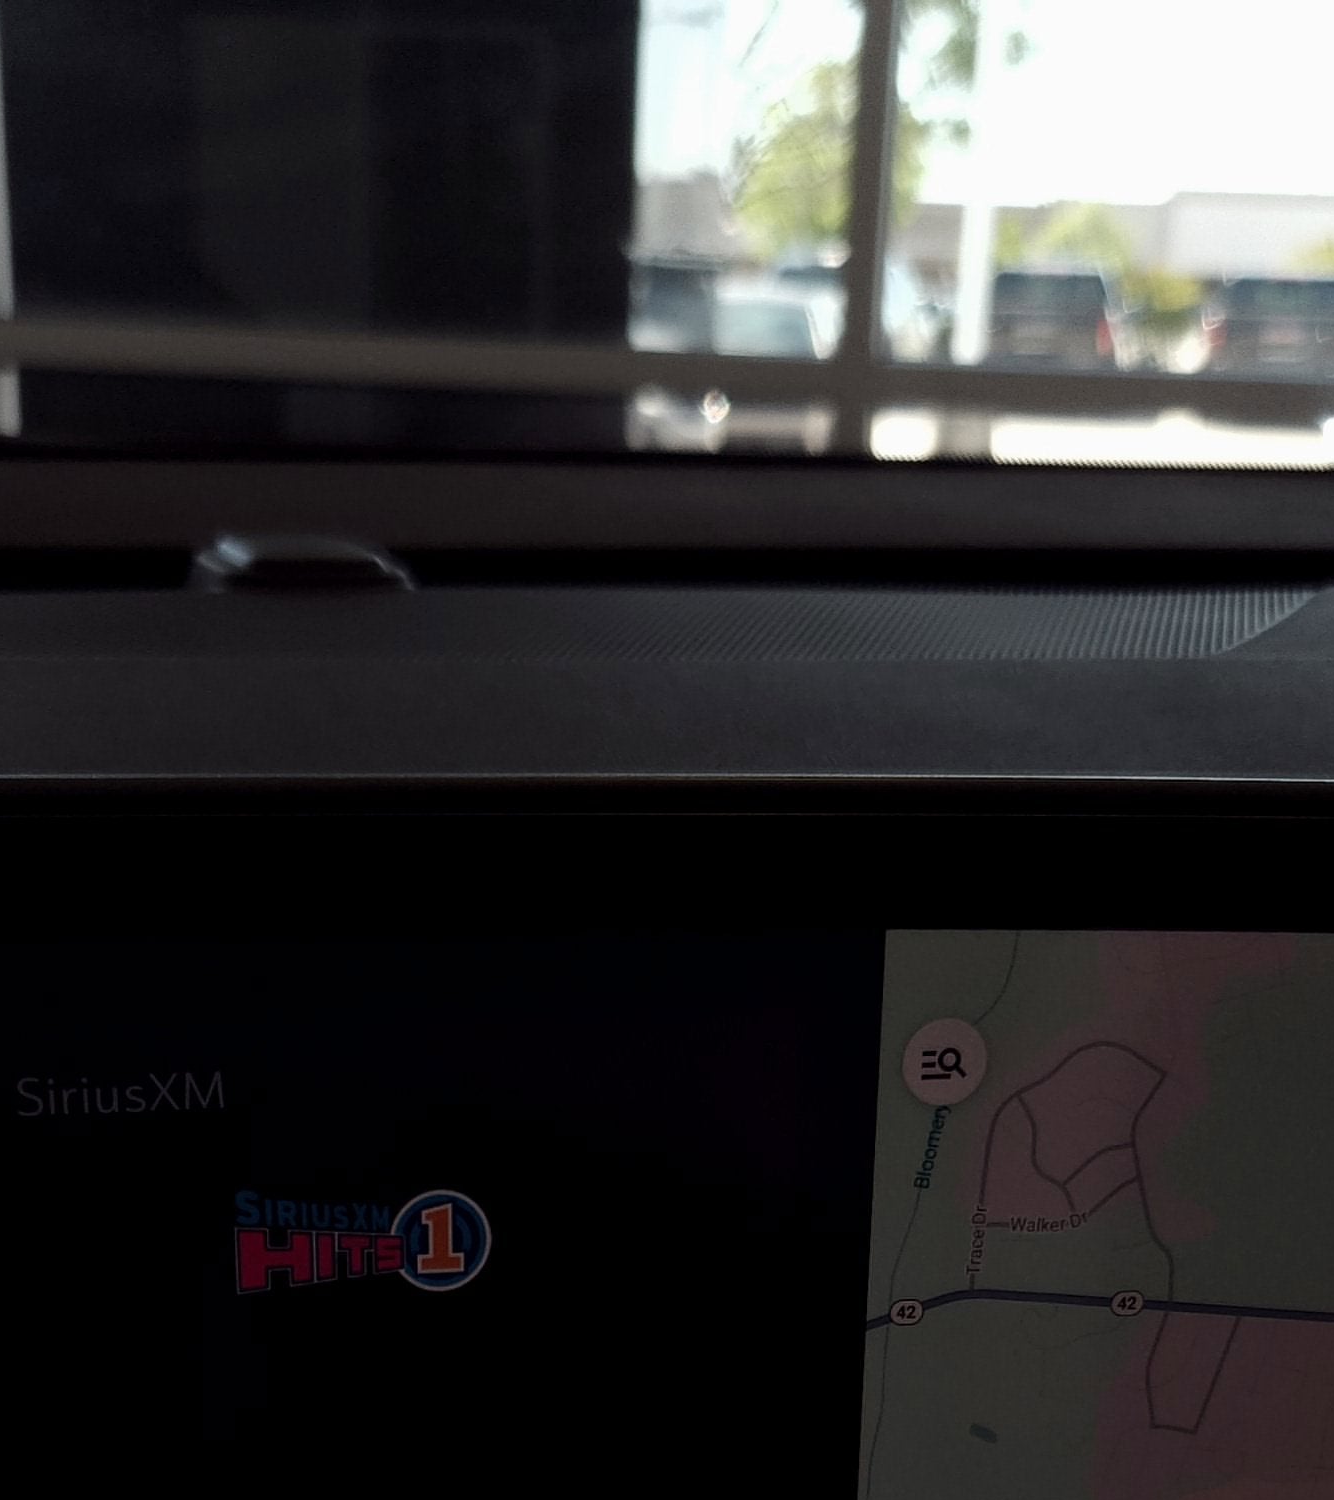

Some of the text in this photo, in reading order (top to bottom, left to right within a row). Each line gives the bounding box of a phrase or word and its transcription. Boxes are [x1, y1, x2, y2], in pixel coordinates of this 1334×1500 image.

[15, 1070, 226, 1117] SiriusXM
[913, 1104, 952, 1190] Bloomery
[416, 1202, 466, 1276] 1
[966, 1205, 988, 1275] Trace Dr
[1010, 1210, 1089, 1233] Walker Dr
[897, 1304, 916, 1320] 42
[1118, 1296, 1136, 1311] 42
